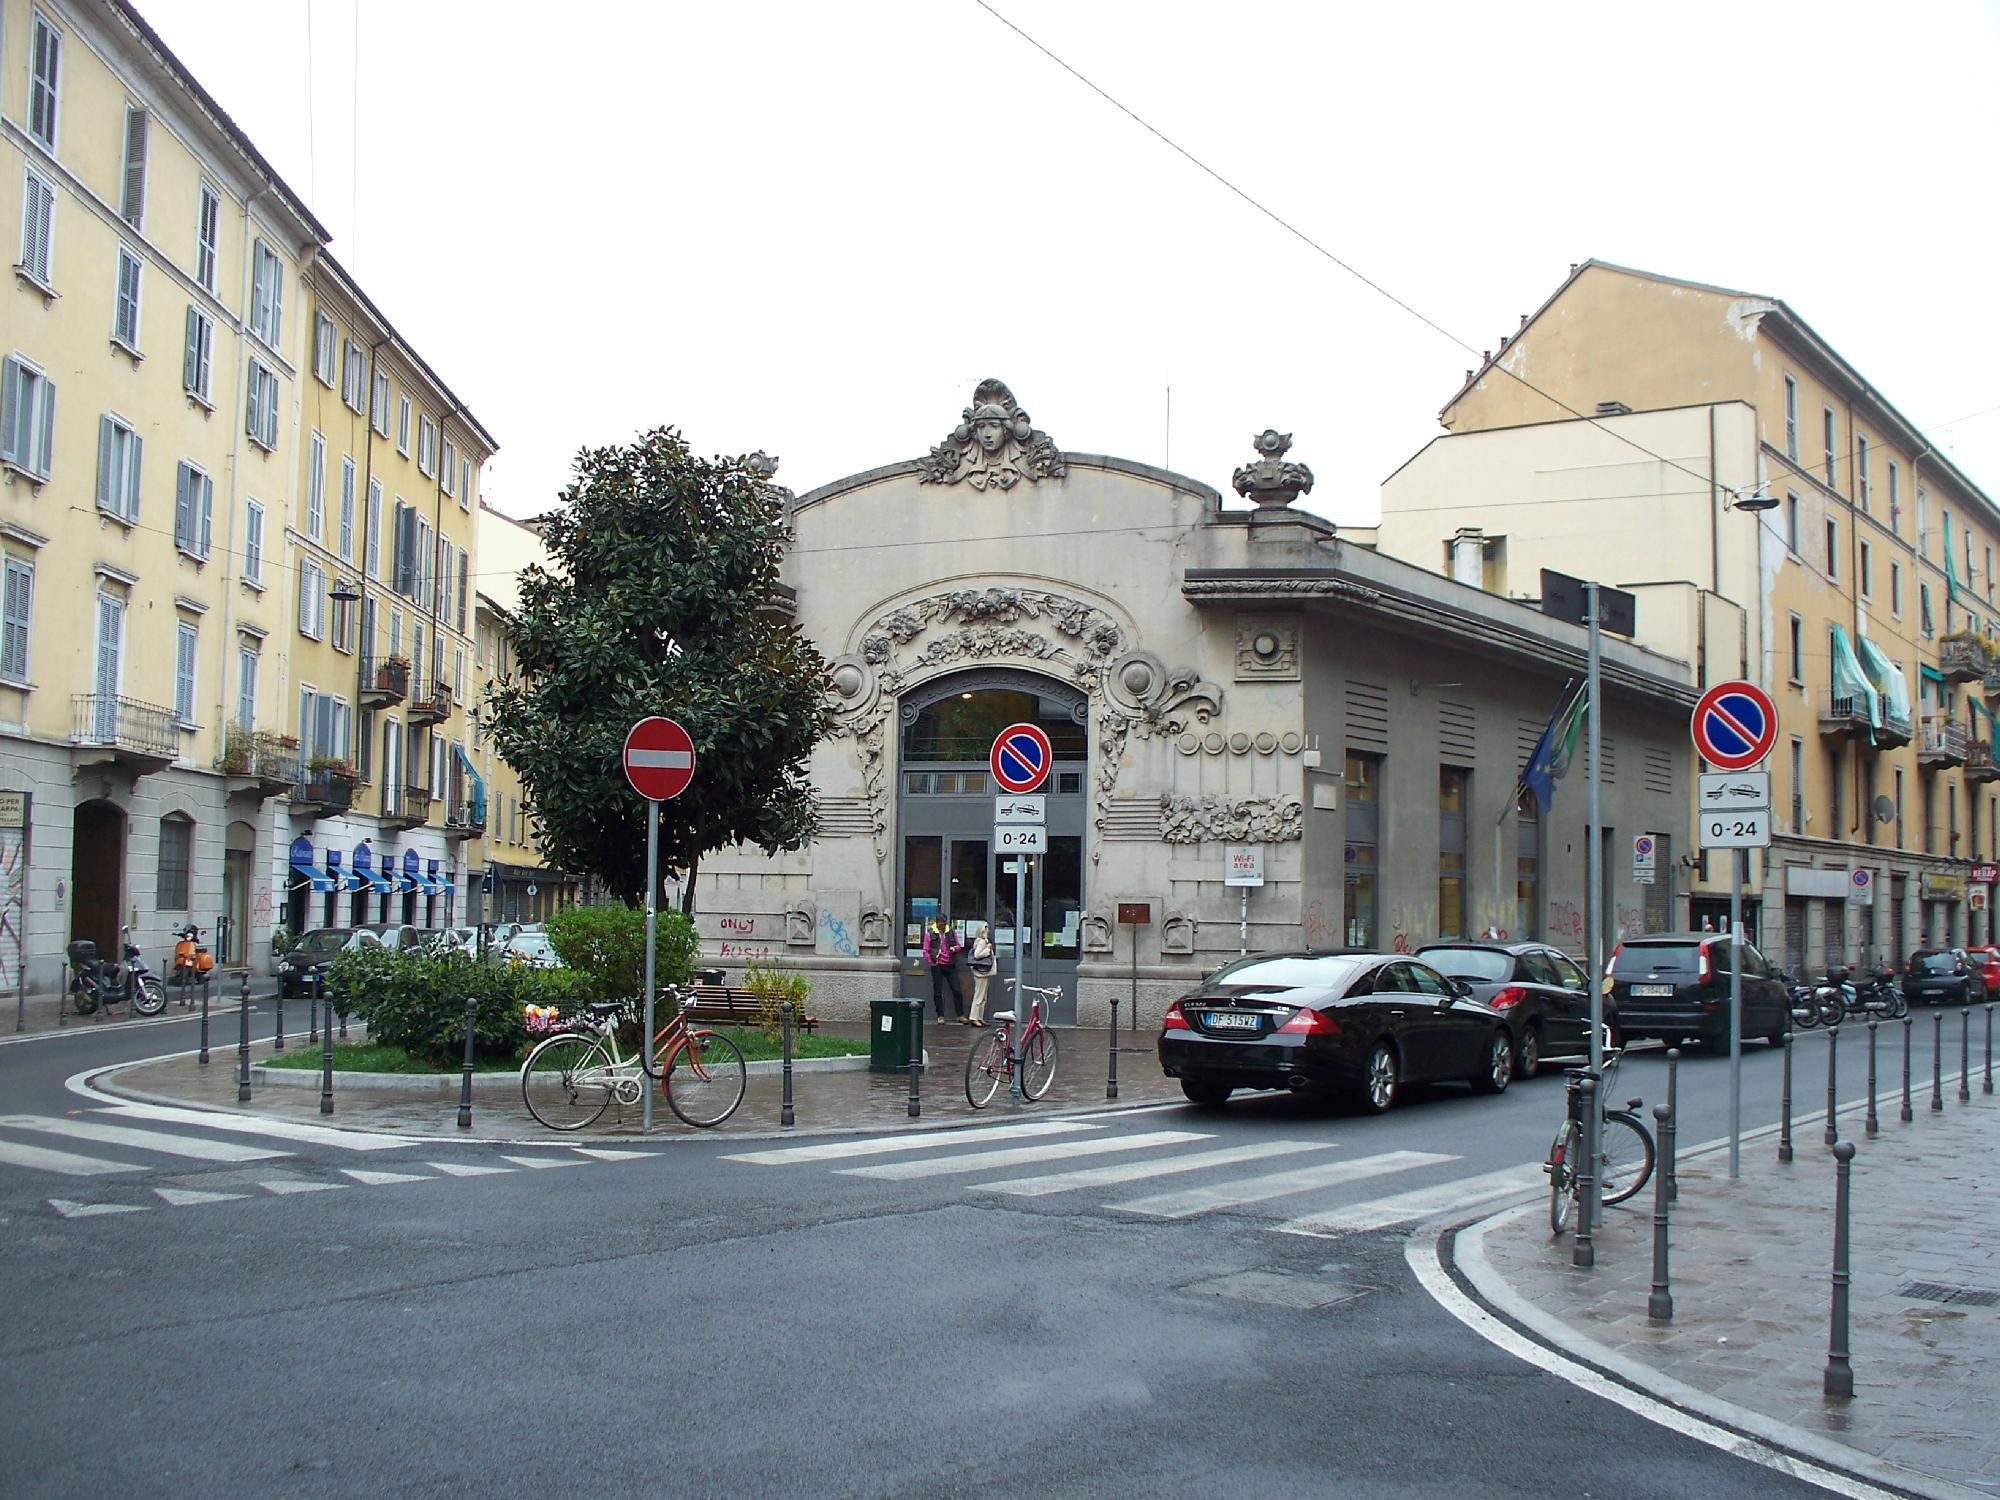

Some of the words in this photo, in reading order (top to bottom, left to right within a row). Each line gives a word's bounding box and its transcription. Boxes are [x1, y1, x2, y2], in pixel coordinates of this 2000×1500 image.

[1711, 821, 1758, 838] 0-24
[1003, 832, 1037, 845] 0-24
[1233, 854, 1255, 863] Wi-Fi
[720, 918, 755, 934] ONLY
[1226, 1014, 1256, 1028] 515WZ
